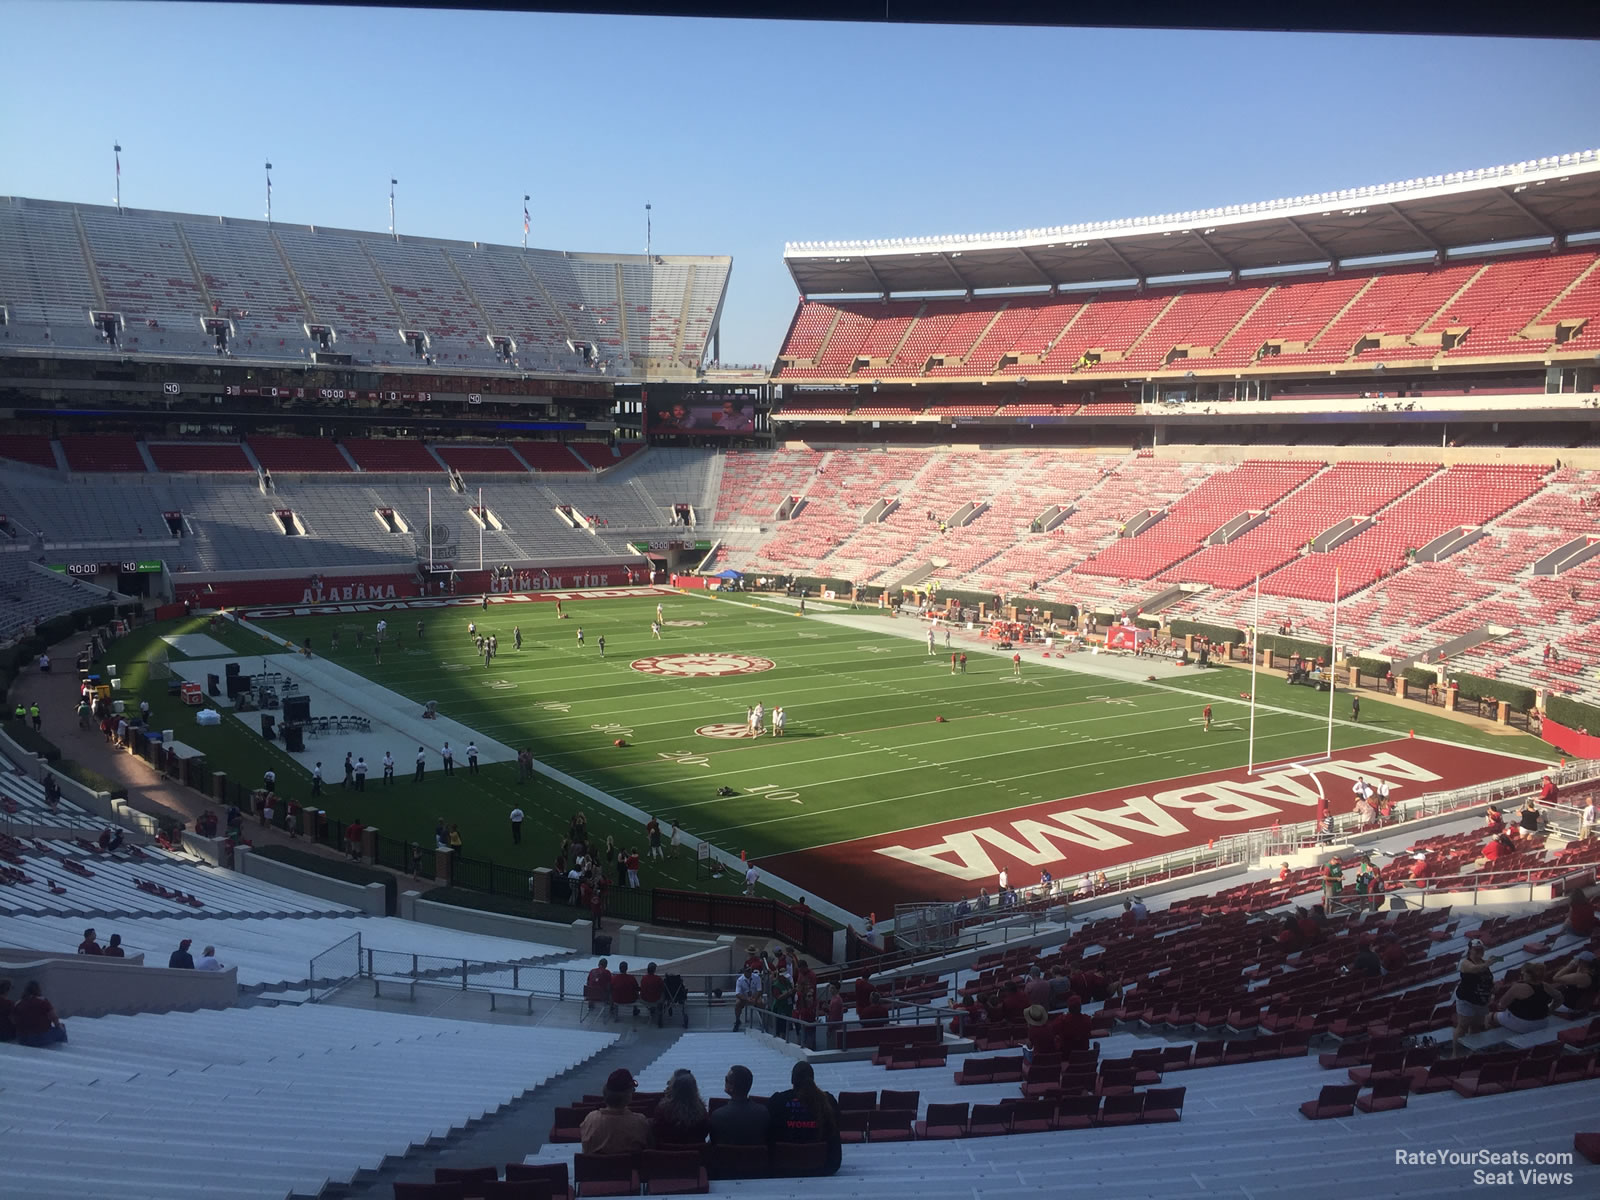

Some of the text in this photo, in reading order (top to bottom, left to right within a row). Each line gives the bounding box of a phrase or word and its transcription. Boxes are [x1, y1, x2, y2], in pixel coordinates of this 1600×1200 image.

[69, 564, 97, 573] 90:00
[123, 562, 136, 571] 40
[302, 583, 397, 603] ALABAMA
[490, 575, 609, 593] CRIMSON TIDE
[244, 587, 666, 618] CRIMSON TIDE
[744, 783, 801, 801] 10
[872, 751, 1444, 882] ALABAMA
